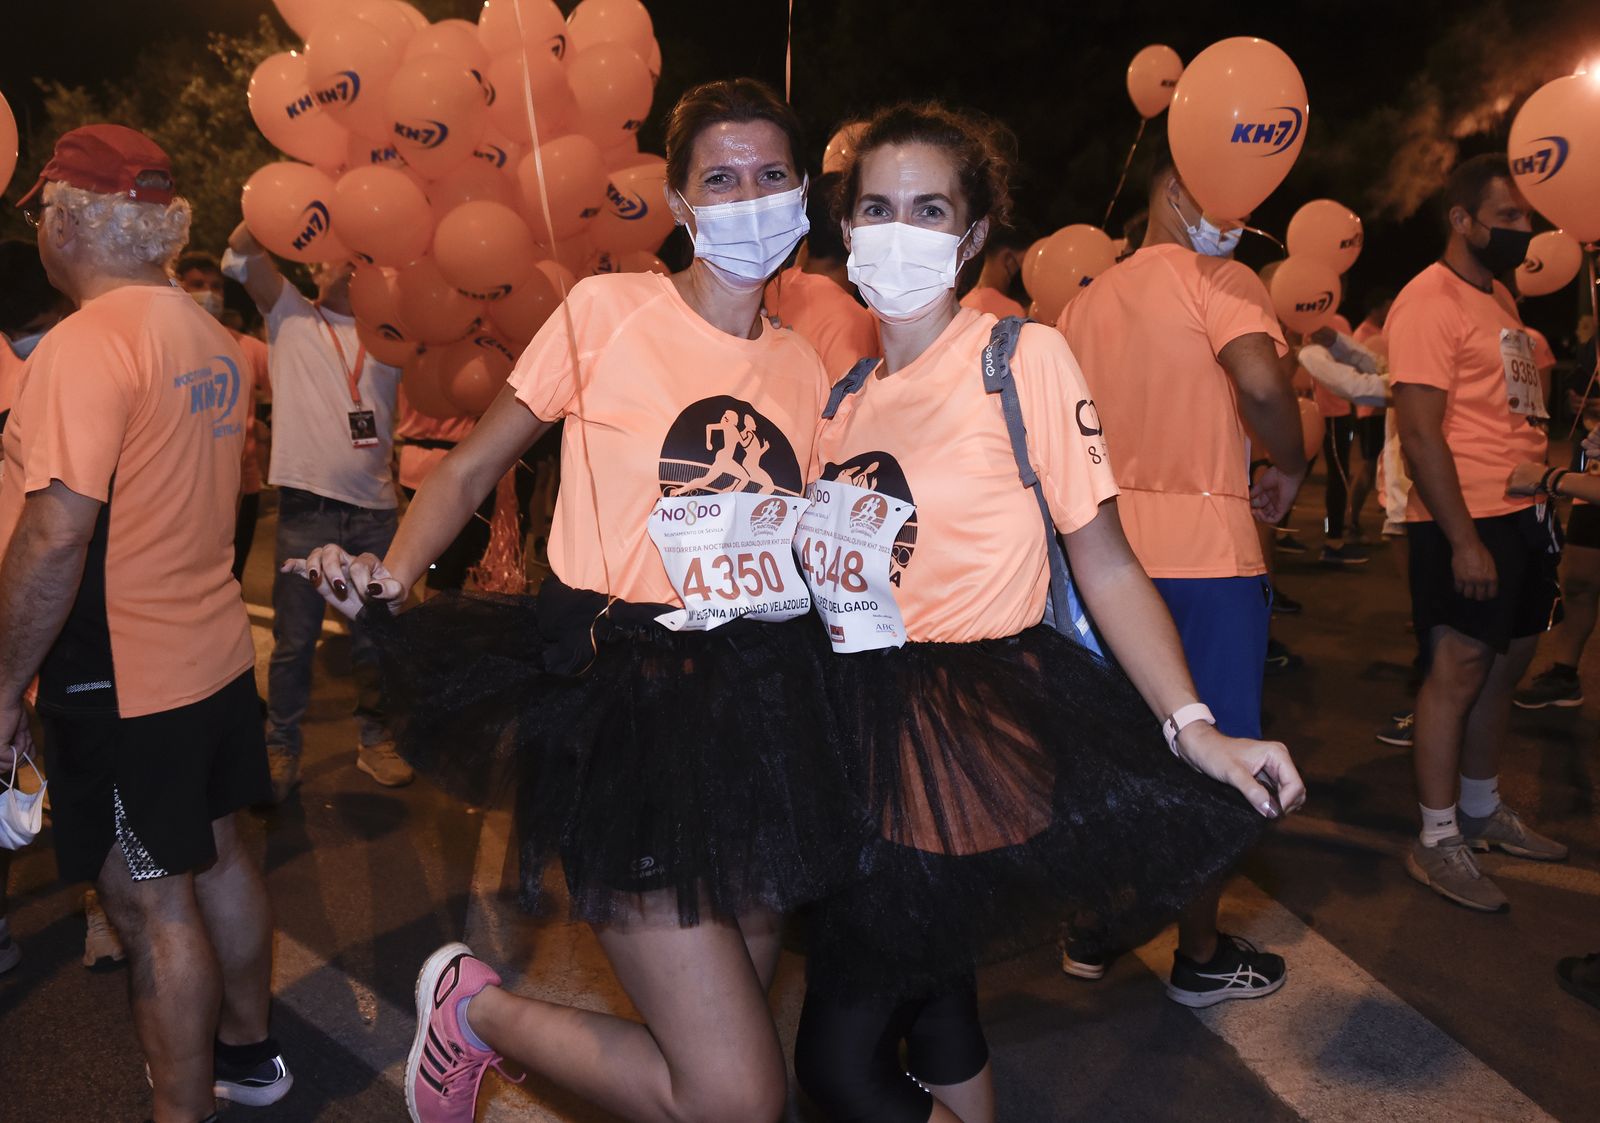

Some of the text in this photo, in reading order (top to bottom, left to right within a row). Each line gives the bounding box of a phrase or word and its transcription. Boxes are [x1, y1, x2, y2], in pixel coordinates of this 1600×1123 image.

[683, 551, 785, 601] 4350
[802, 537, 868, 593] 4348
[770, 598, 809, 612] VELAZQUEZ
[829, 601, 878, 613] DELGADO
